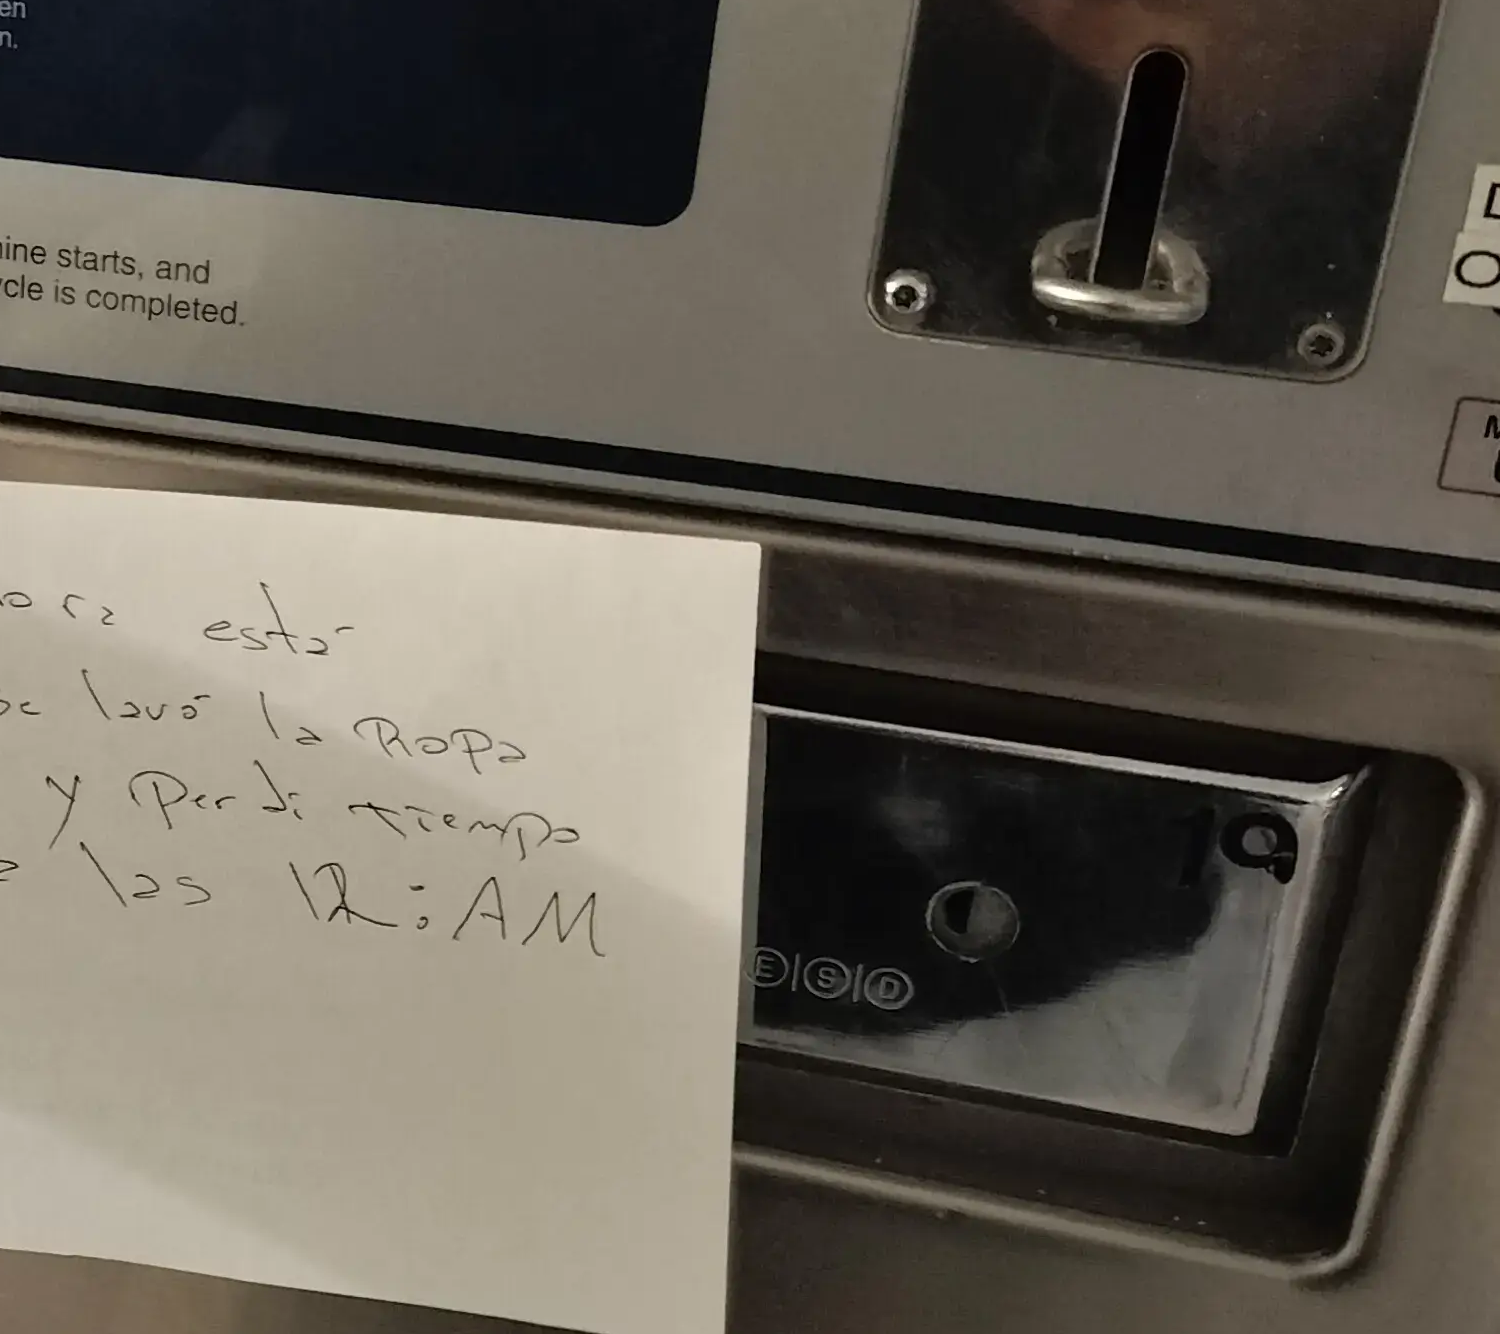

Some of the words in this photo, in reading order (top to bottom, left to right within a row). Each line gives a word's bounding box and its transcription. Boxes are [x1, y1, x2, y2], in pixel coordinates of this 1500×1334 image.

[56, 245, 145, 281] starts,
[155, 257, 210, 285] and
[53, 280, 76, 306] is
[86, 286, 247, 328] completed.
[259, 690, 323, 746] la
[79, 840, 212, 908] las
